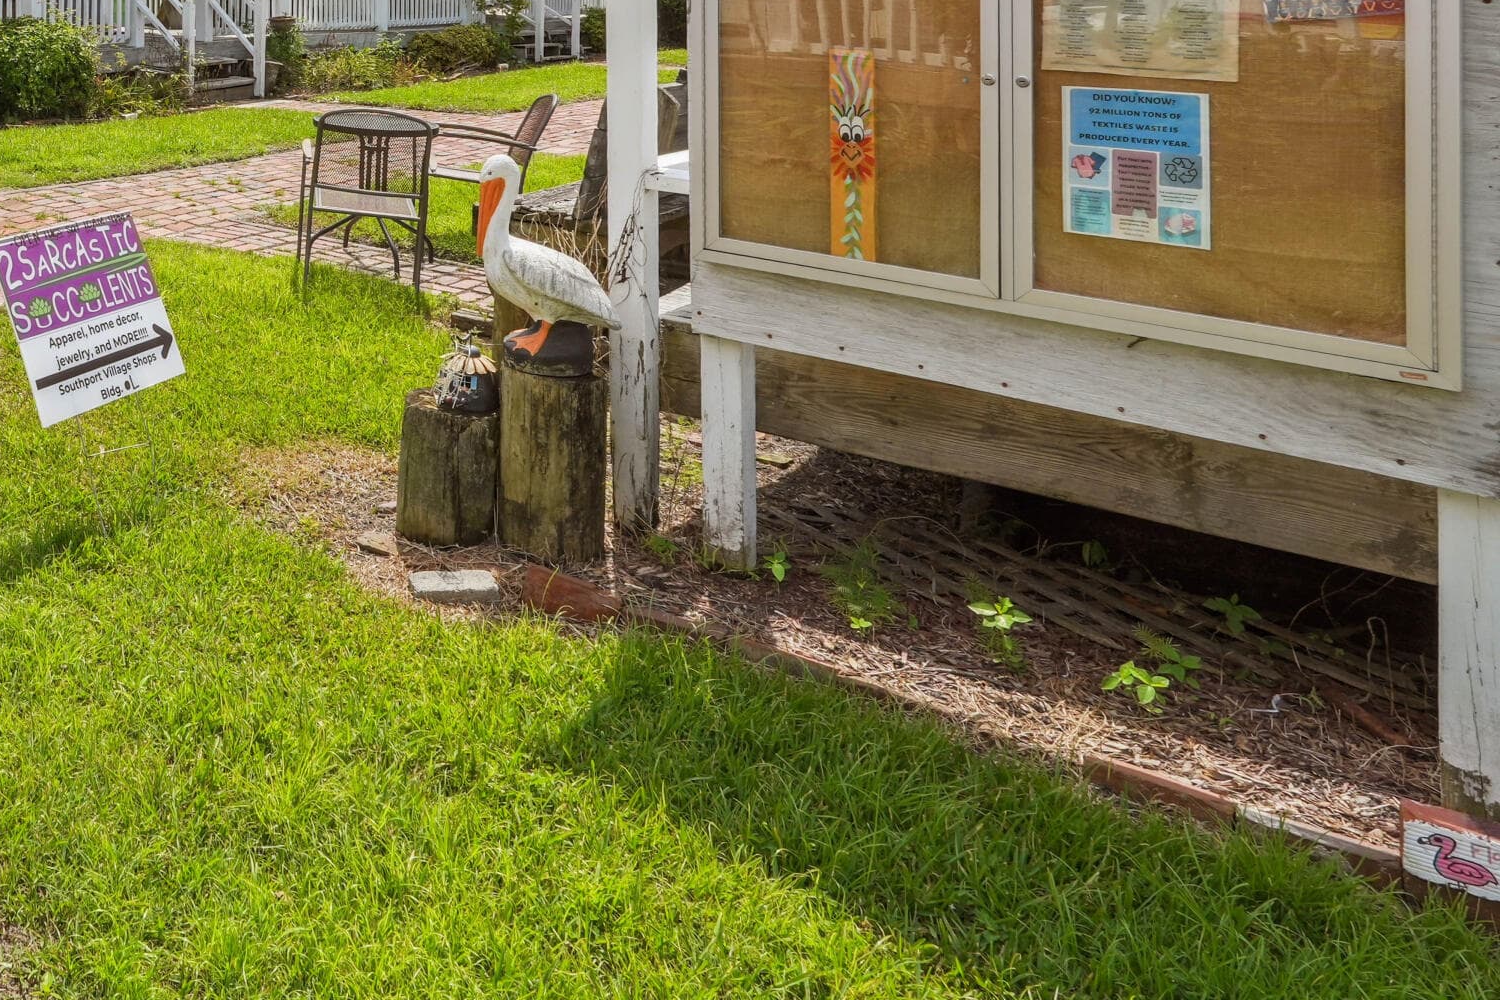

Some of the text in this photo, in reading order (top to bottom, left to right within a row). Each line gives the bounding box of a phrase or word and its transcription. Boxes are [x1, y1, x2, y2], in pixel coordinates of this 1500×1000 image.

[1092, 93, 1177, 106] DID YOU KNOW?
[1102, 108, 1141, 117] MILLION
[1141, 111, 1167, 119] TONS
[1092, 121, 1134, 130] TEXTILES
[1135, 124, 1168, 133] WASTE
[1079, 133, 1192, 148] PRODUCED EVERY YEAR.
[10, 265, 154, 334] SUCCULENTS
[49, 311, 143, 349] Apparel, home decor,
[55, 348, 94, 371] jewelry,
[95, 341, 112, 355] and
[58, 352, 157, 396] Southport Village Shops
[100, 385, 124, 400] Bldg.
